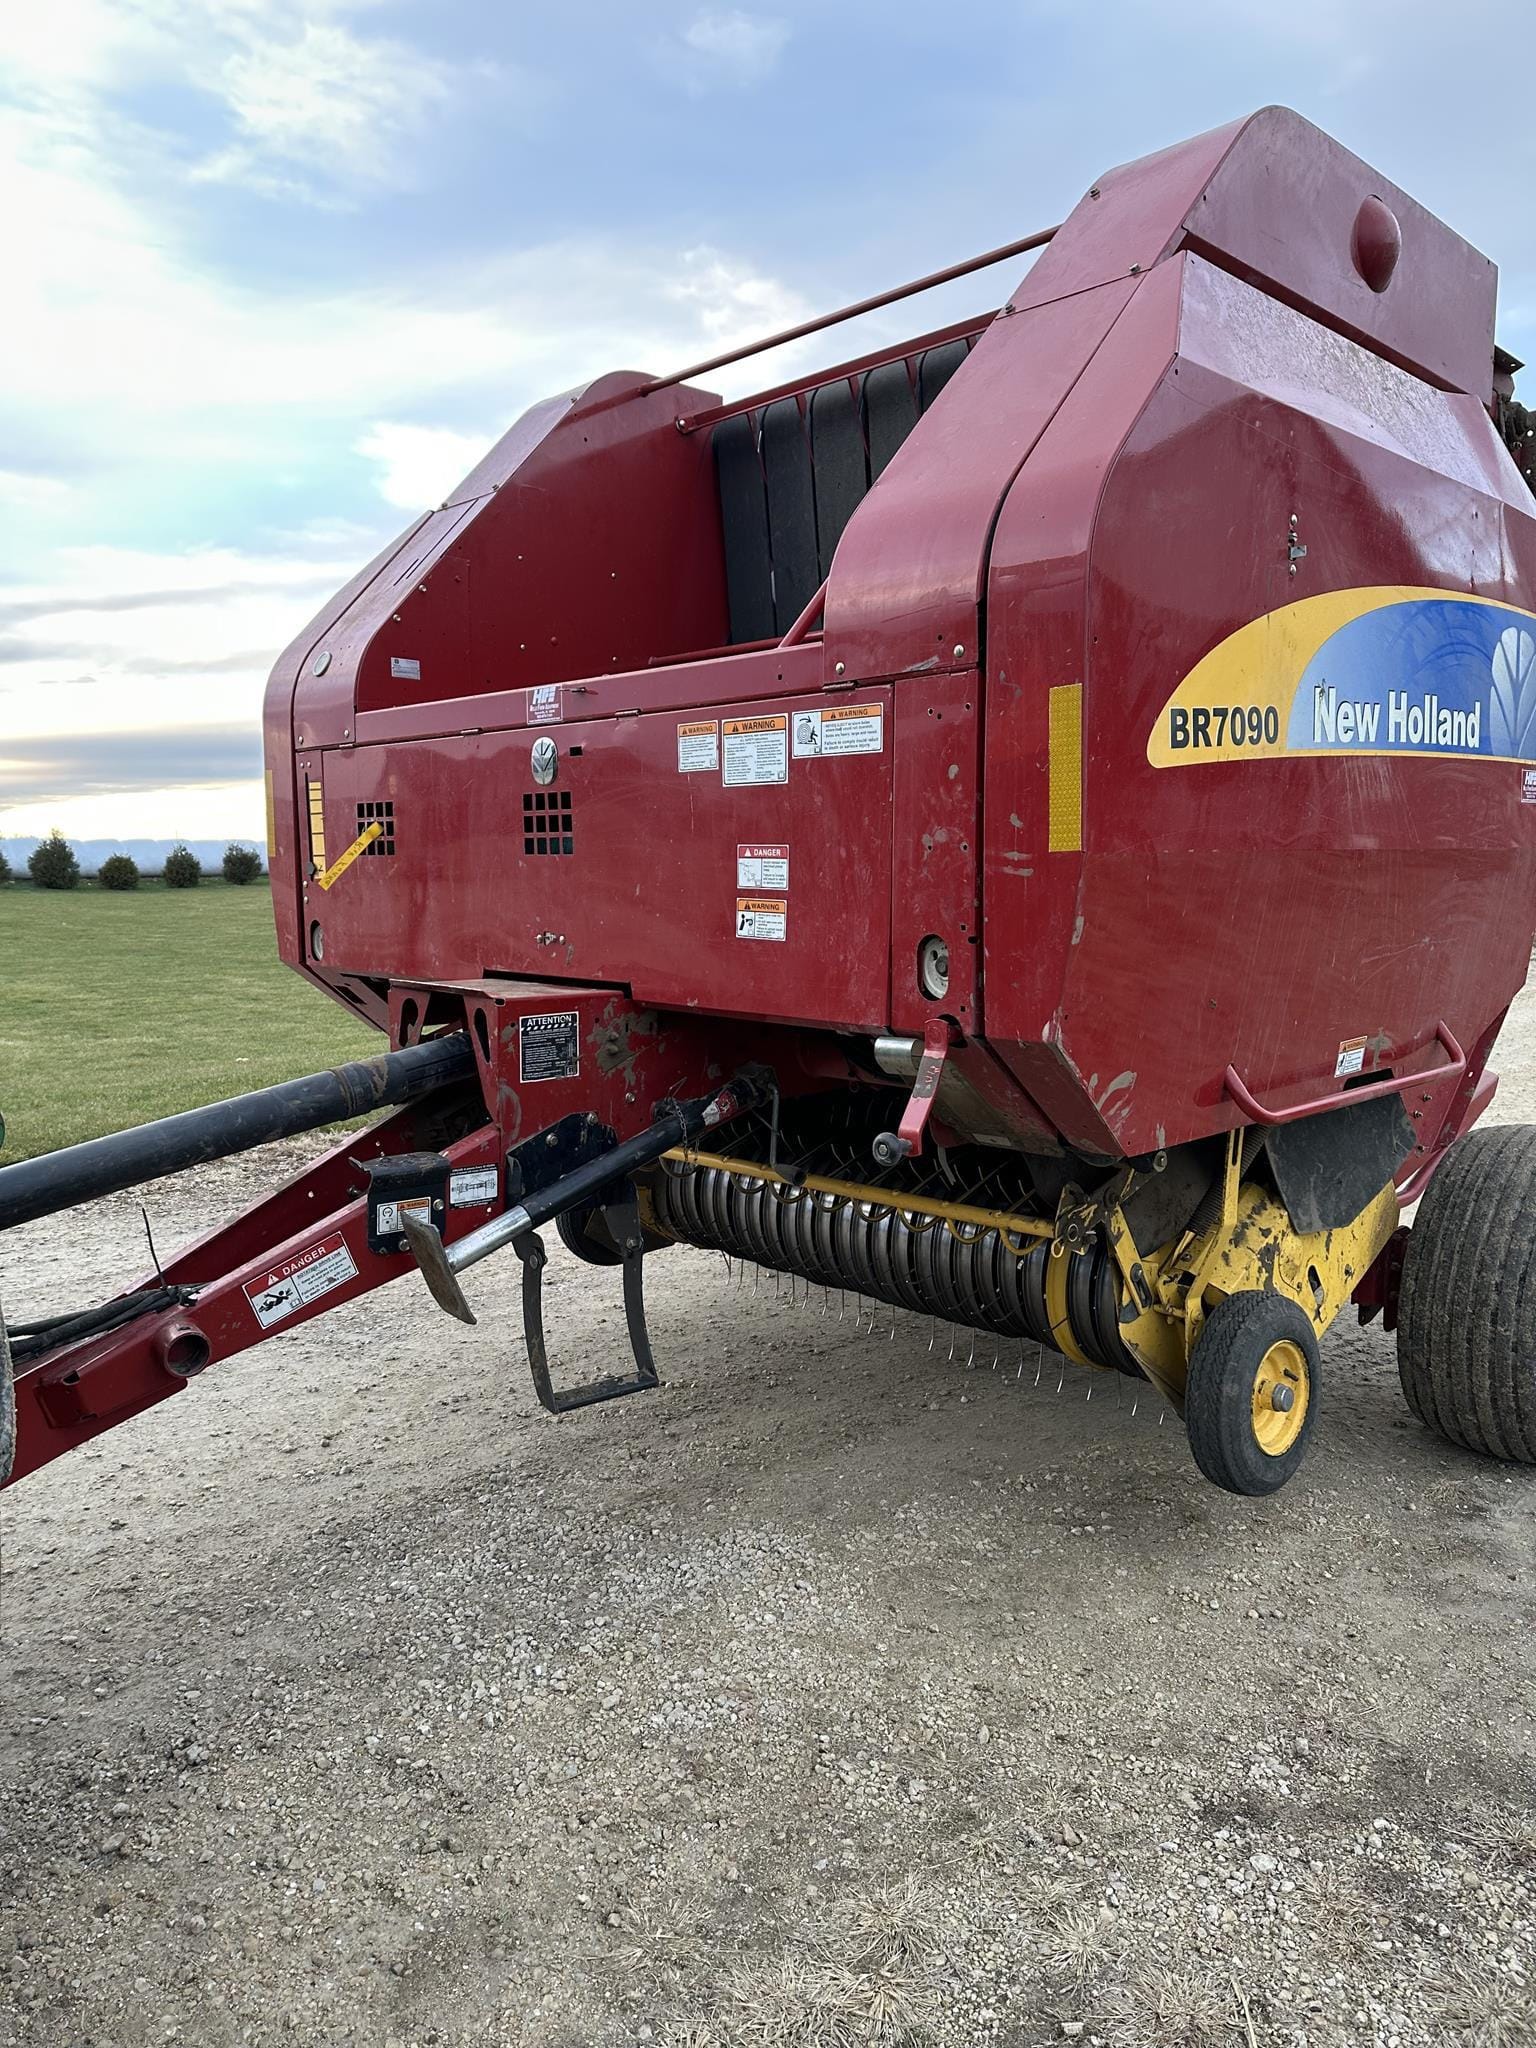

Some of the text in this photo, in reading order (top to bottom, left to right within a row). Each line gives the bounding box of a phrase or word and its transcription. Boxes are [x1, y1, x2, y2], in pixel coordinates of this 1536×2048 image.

[838, 708, 868, 718] WARNING
[1313, 686, 1481, 748] New Holland
[688, 725, 713, 734] WARNING
[742, 720, 776, 731] WARNING
[1170, 705, 1279, 749] BR7090
[753, 848, 781, 857] DANGER
[751, 902, 780, 911] WARNING
[526, 1015, 572, 1027] ATTENTION
[282, 1246, 327, 1276] DANGER
